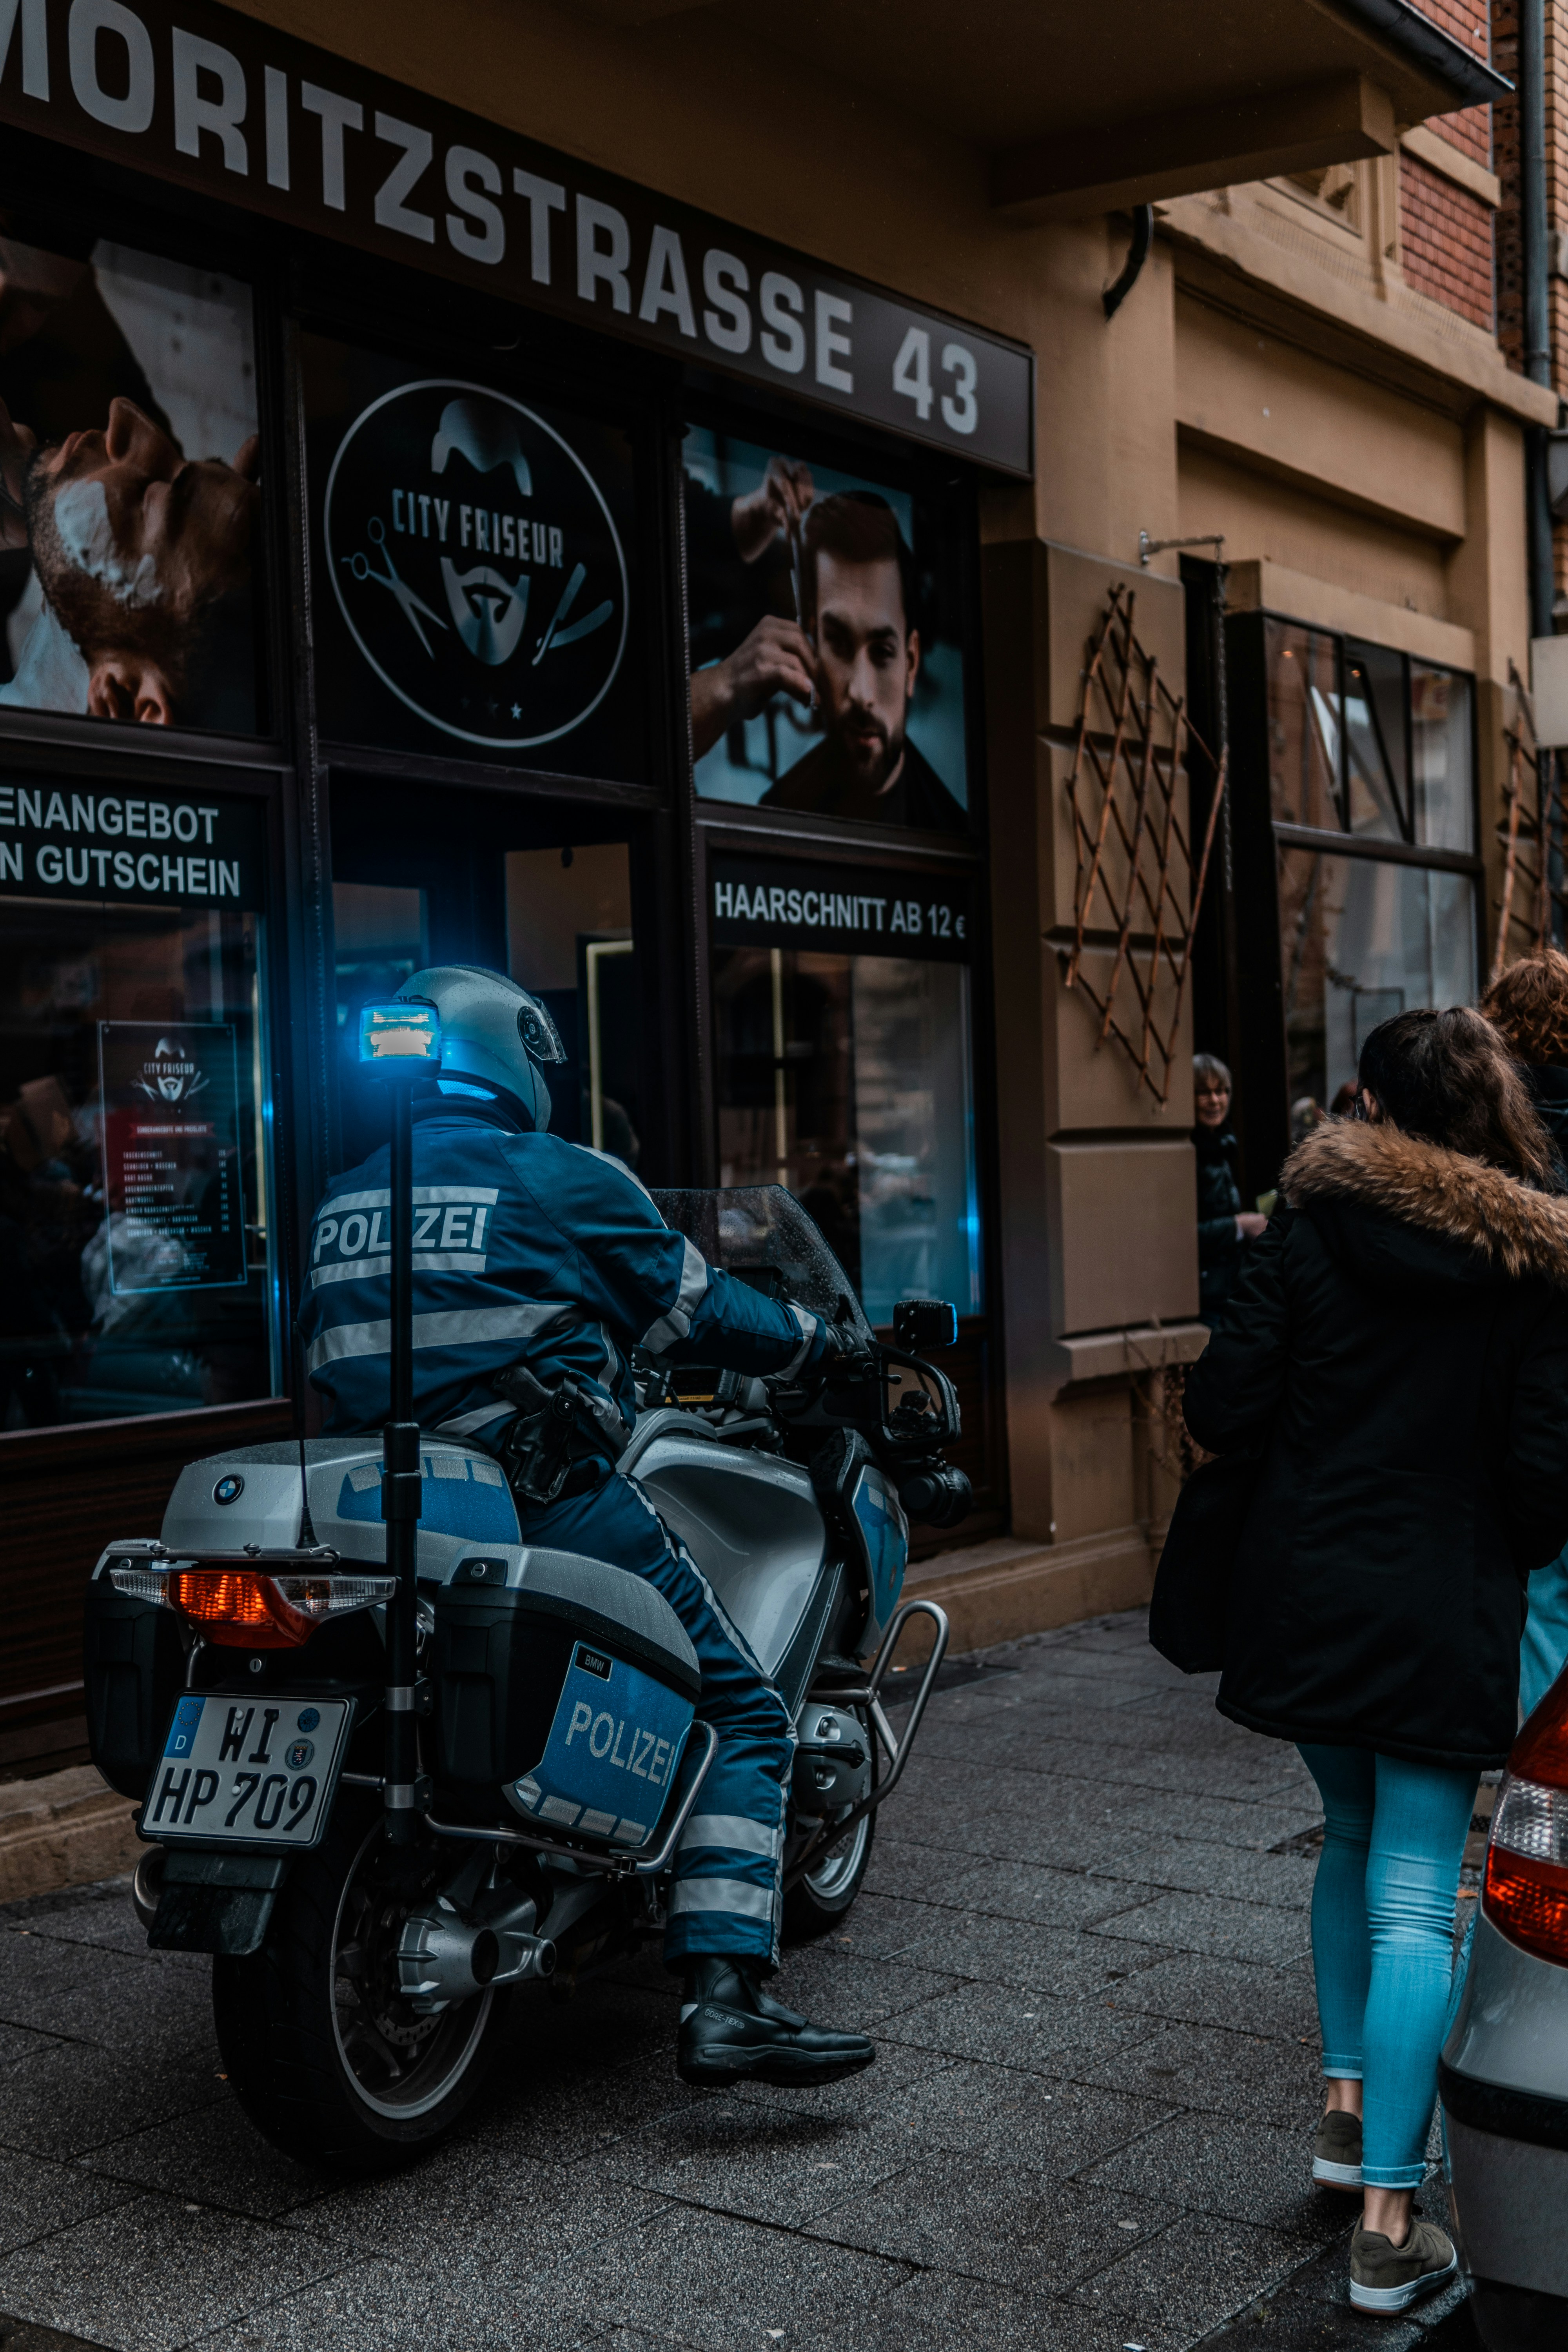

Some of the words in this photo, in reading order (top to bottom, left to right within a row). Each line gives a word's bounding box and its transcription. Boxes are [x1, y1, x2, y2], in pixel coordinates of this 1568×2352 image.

[892, 326, 978, 435] 43
[392, 488, 450, 542] CITY
[459, 504, 564, 569] FRISEUR
[36, 844, 240, 897] GUTSCHEIN
[715, 881, 887, 932] HAARSCHNITT
[890, 900, 923, 935] AB
[927, 904, 951, 938] 12
[955, 915, 966, 940] €
[143, 1062, 160, 1074] CITY
[163, 1062, 194, 1074] FRISEUR
[314, 1207, 487, 1263] POLZEI
[585, 1654, 604, 1672] BMW
[175, 1735, 187, 1750] D
[219, 1706, 280, 1764] WI
[565, 1700, 675, 1788] POLIZEI
[152, 1767, 220, 1824] HP
[224, 1771, 317, 1831] 709
